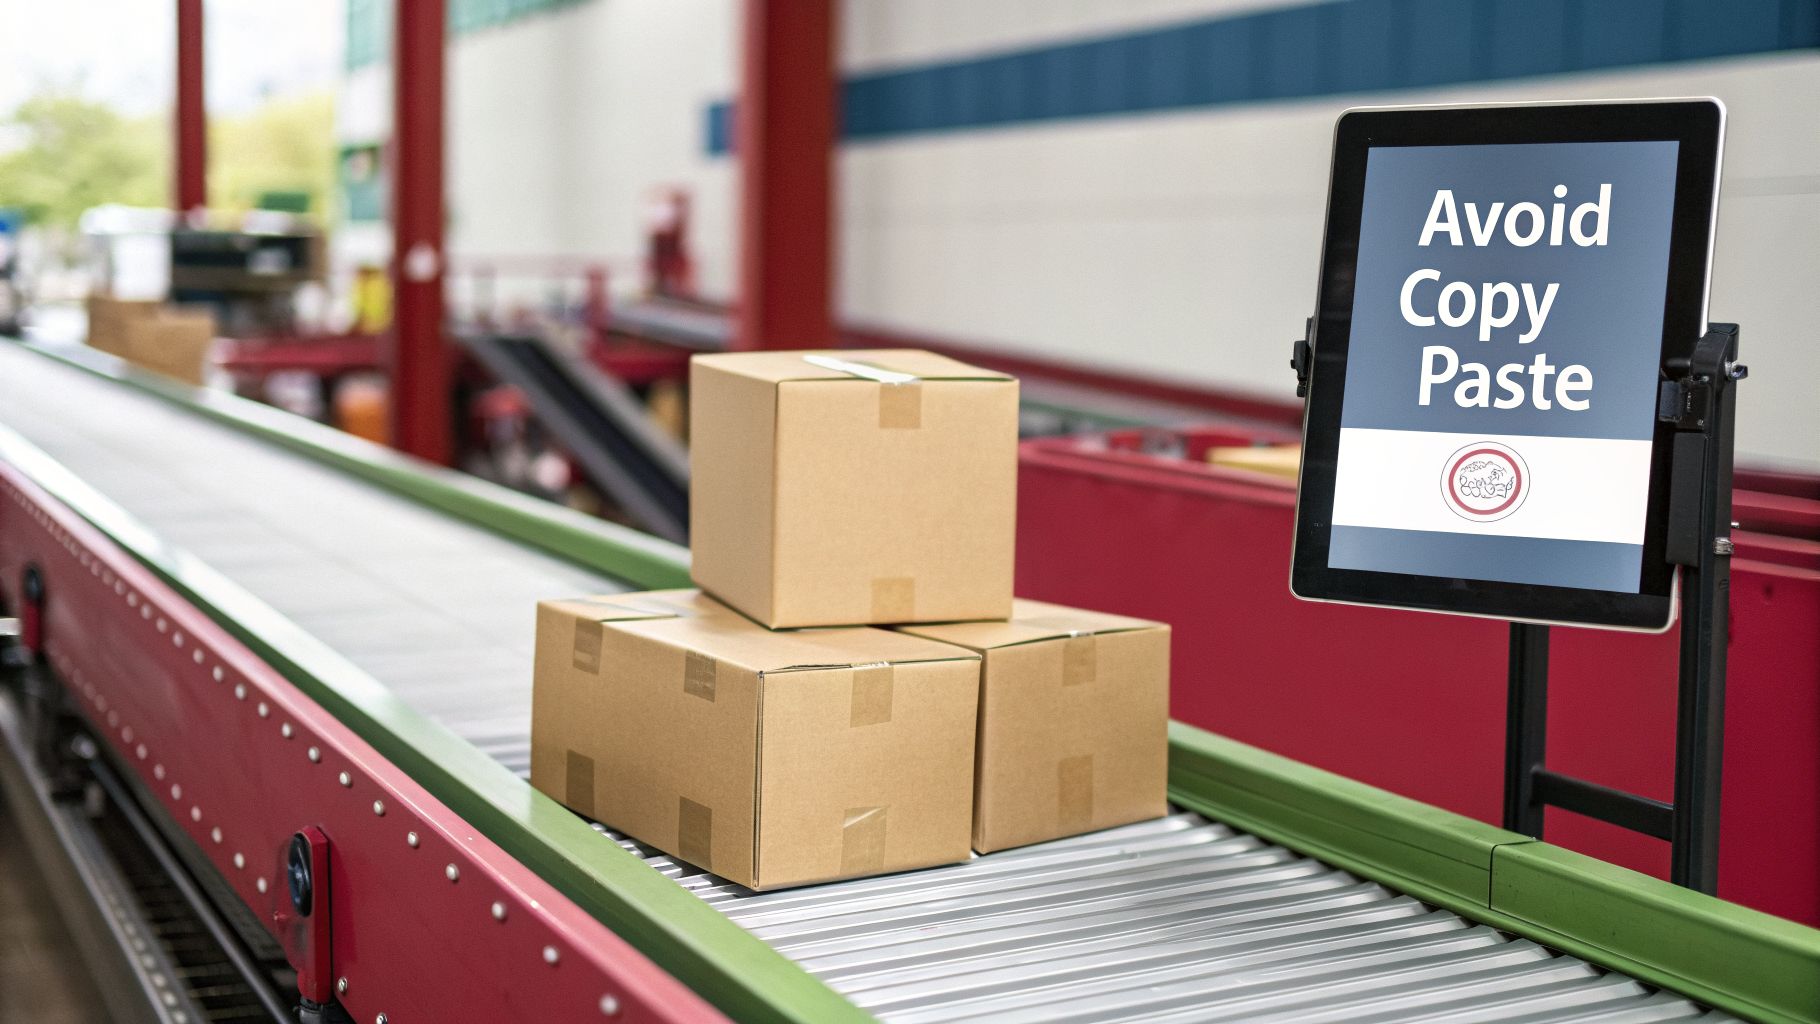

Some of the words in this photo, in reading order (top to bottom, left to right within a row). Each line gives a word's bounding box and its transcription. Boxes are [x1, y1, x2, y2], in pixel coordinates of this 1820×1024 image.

[1417, 183, 1612, 247] Avoid
[1399, 268, 1560, 343] Copy
[1418, 345, 1593, 411] Paste
